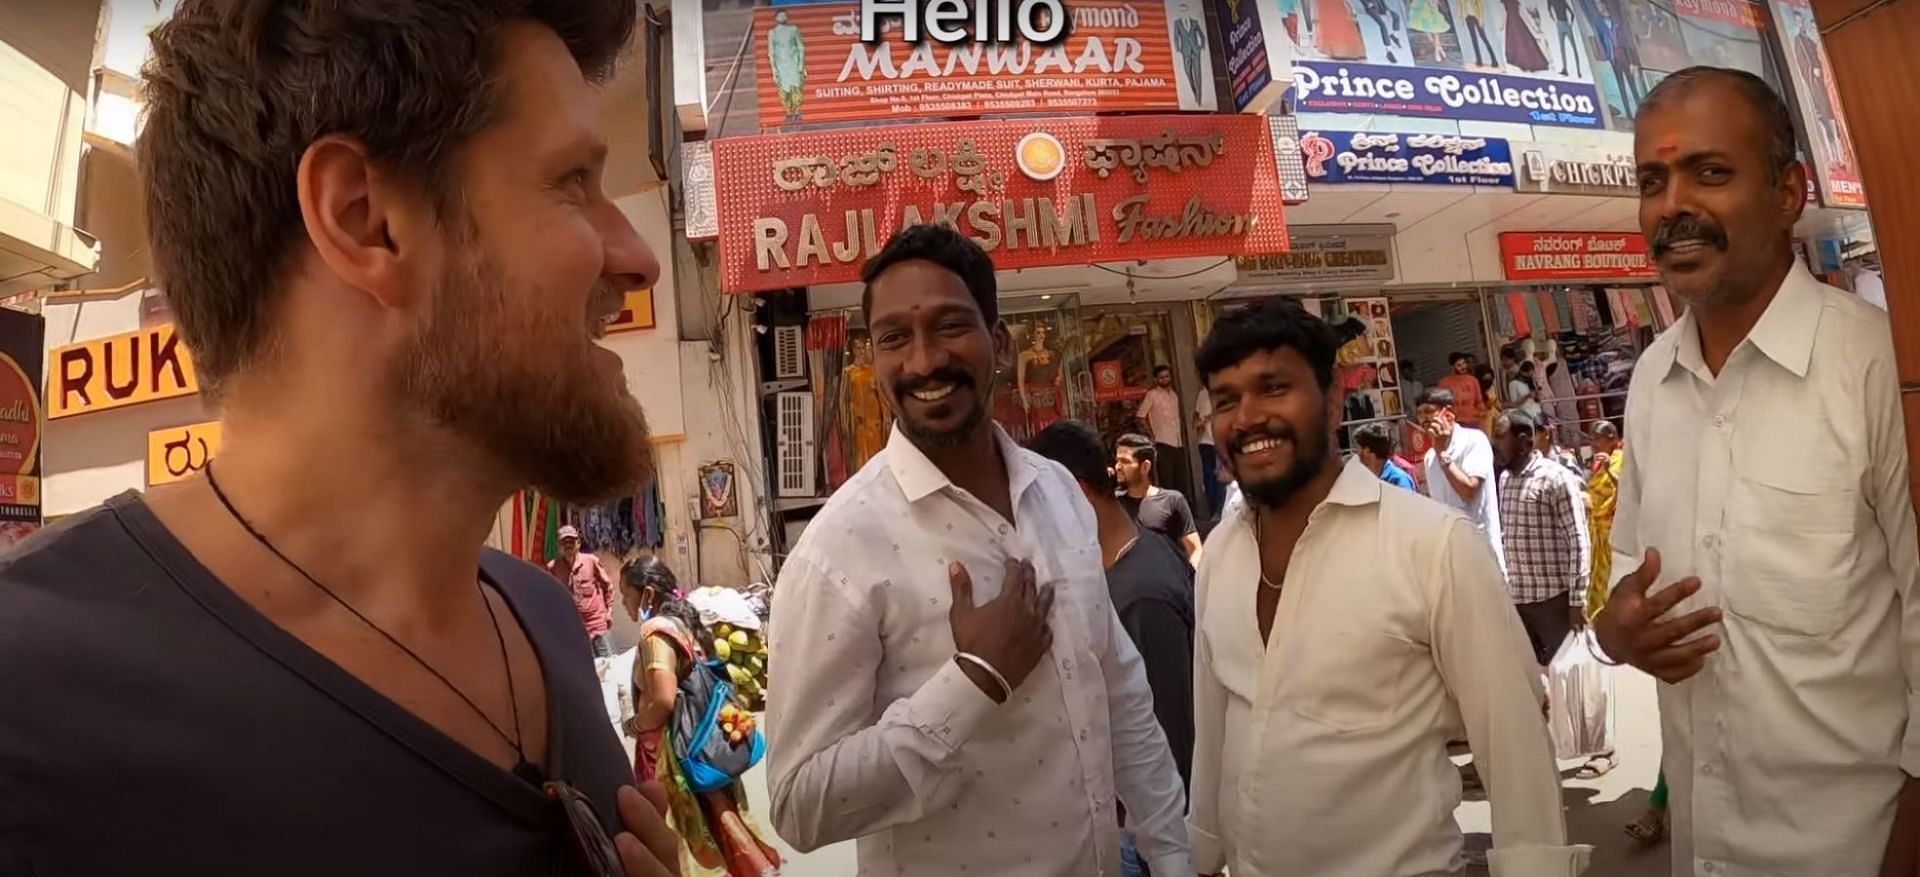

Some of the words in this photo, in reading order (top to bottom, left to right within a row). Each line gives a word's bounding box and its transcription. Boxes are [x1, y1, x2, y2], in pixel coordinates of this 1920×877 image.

[836, 36, 1145, 83] MANWAAR
[815, 87, 864, 98] SUITING,
[866, 83, 922, 95] SHIRTING,
[925, 81, 993, 92] READYMADE
[1024, 77, 1084, 89] SHERWANI,
[1085, 77, 1123, 88] KURTA,
[1125, 78, 1166, 87] PAJAMA
[1290, 65, 1415, 100] Prince
[1424, 74, 1595, 114] Collection
[891, 104, 912, 113] Mob
[1337, 151, 1409, 174] Prince
[1411, 154, 1513, 176] Collection
[1470, 176, 1501, 185] Floor
[1112, 194, 1259, 245] Fashion
[1514, 254, 1581, 270] NAVRANG
[1583, 253, 1648, 271] BOUTIQUE
